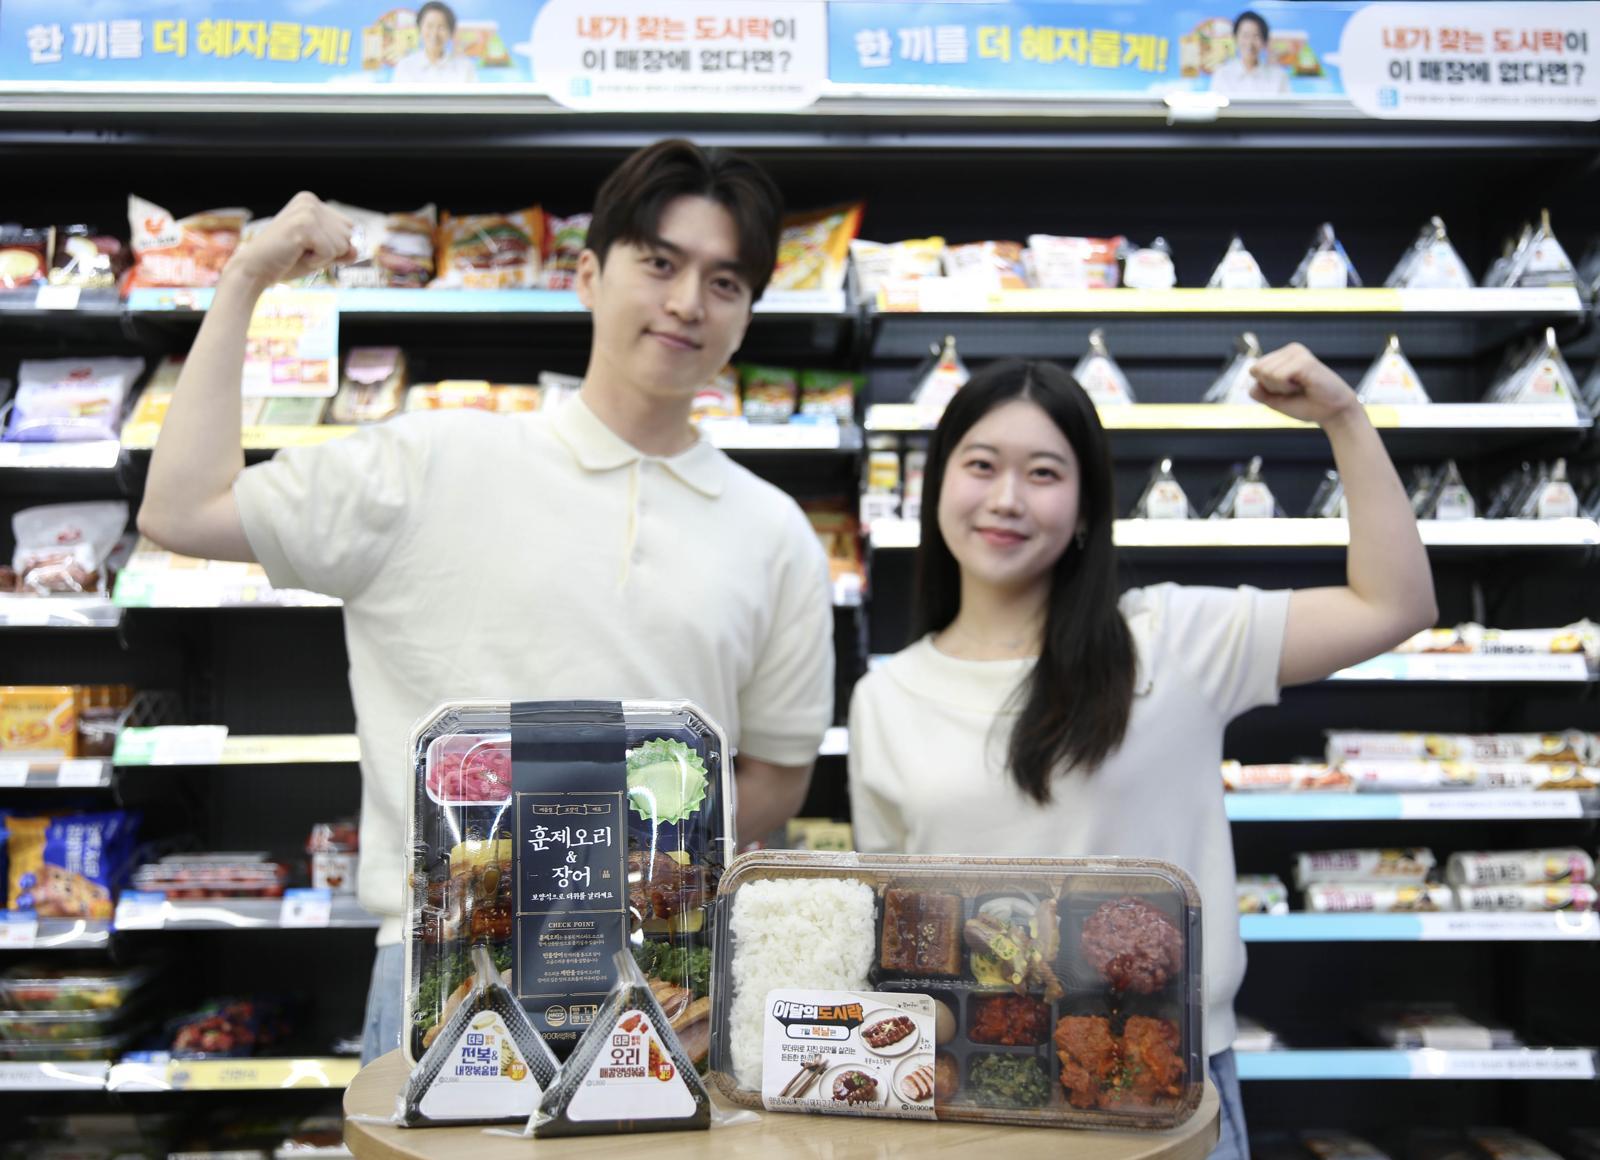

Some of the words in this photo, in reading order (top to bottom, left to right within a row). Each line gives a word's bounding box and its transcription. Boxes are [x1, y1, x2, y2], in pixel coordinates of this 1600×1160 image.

[577, 15, 629, 40] 내가
[637, 16, 686, 41] 찾는
[695, 17, 796, 41] 도시락이
[1382, 26, 1430, 51] 내가
[1439, 28, 1484, 53] 찾는
[1493, 29, 1588, 54] 도시락이
[27, 25, 64, 65] 한
[72, 20, 143, 59] 끼를
[152, 21, 188, 58] 더
[197, 20, 352, 66] 혜자롭게!
[855, 28, 893, 68] 한
[897, 24, 968, 64] 끼를
[977, 26, 1011, 63] 더
[1020, 25, 1168, 73] 혜자롭게!
[582, 49, 607, 71] 이
[614, 49, 692, 71] 매장에
[700, 50, 792, 73] 없다면?
[1389, 60, 1412, 82] 이
[1419, 61, 1491, 84] 매장에
[1497, 62, 1585, 85] 없다면?
[528, 825, 612, 851] 훈제오리
[565, 850, 578, 864] &
[552, 865, 591, 888] 장어
[611, 1048, 640, 1066] 오리
[455, 1065, 499, 1077] 내장볶음밥
